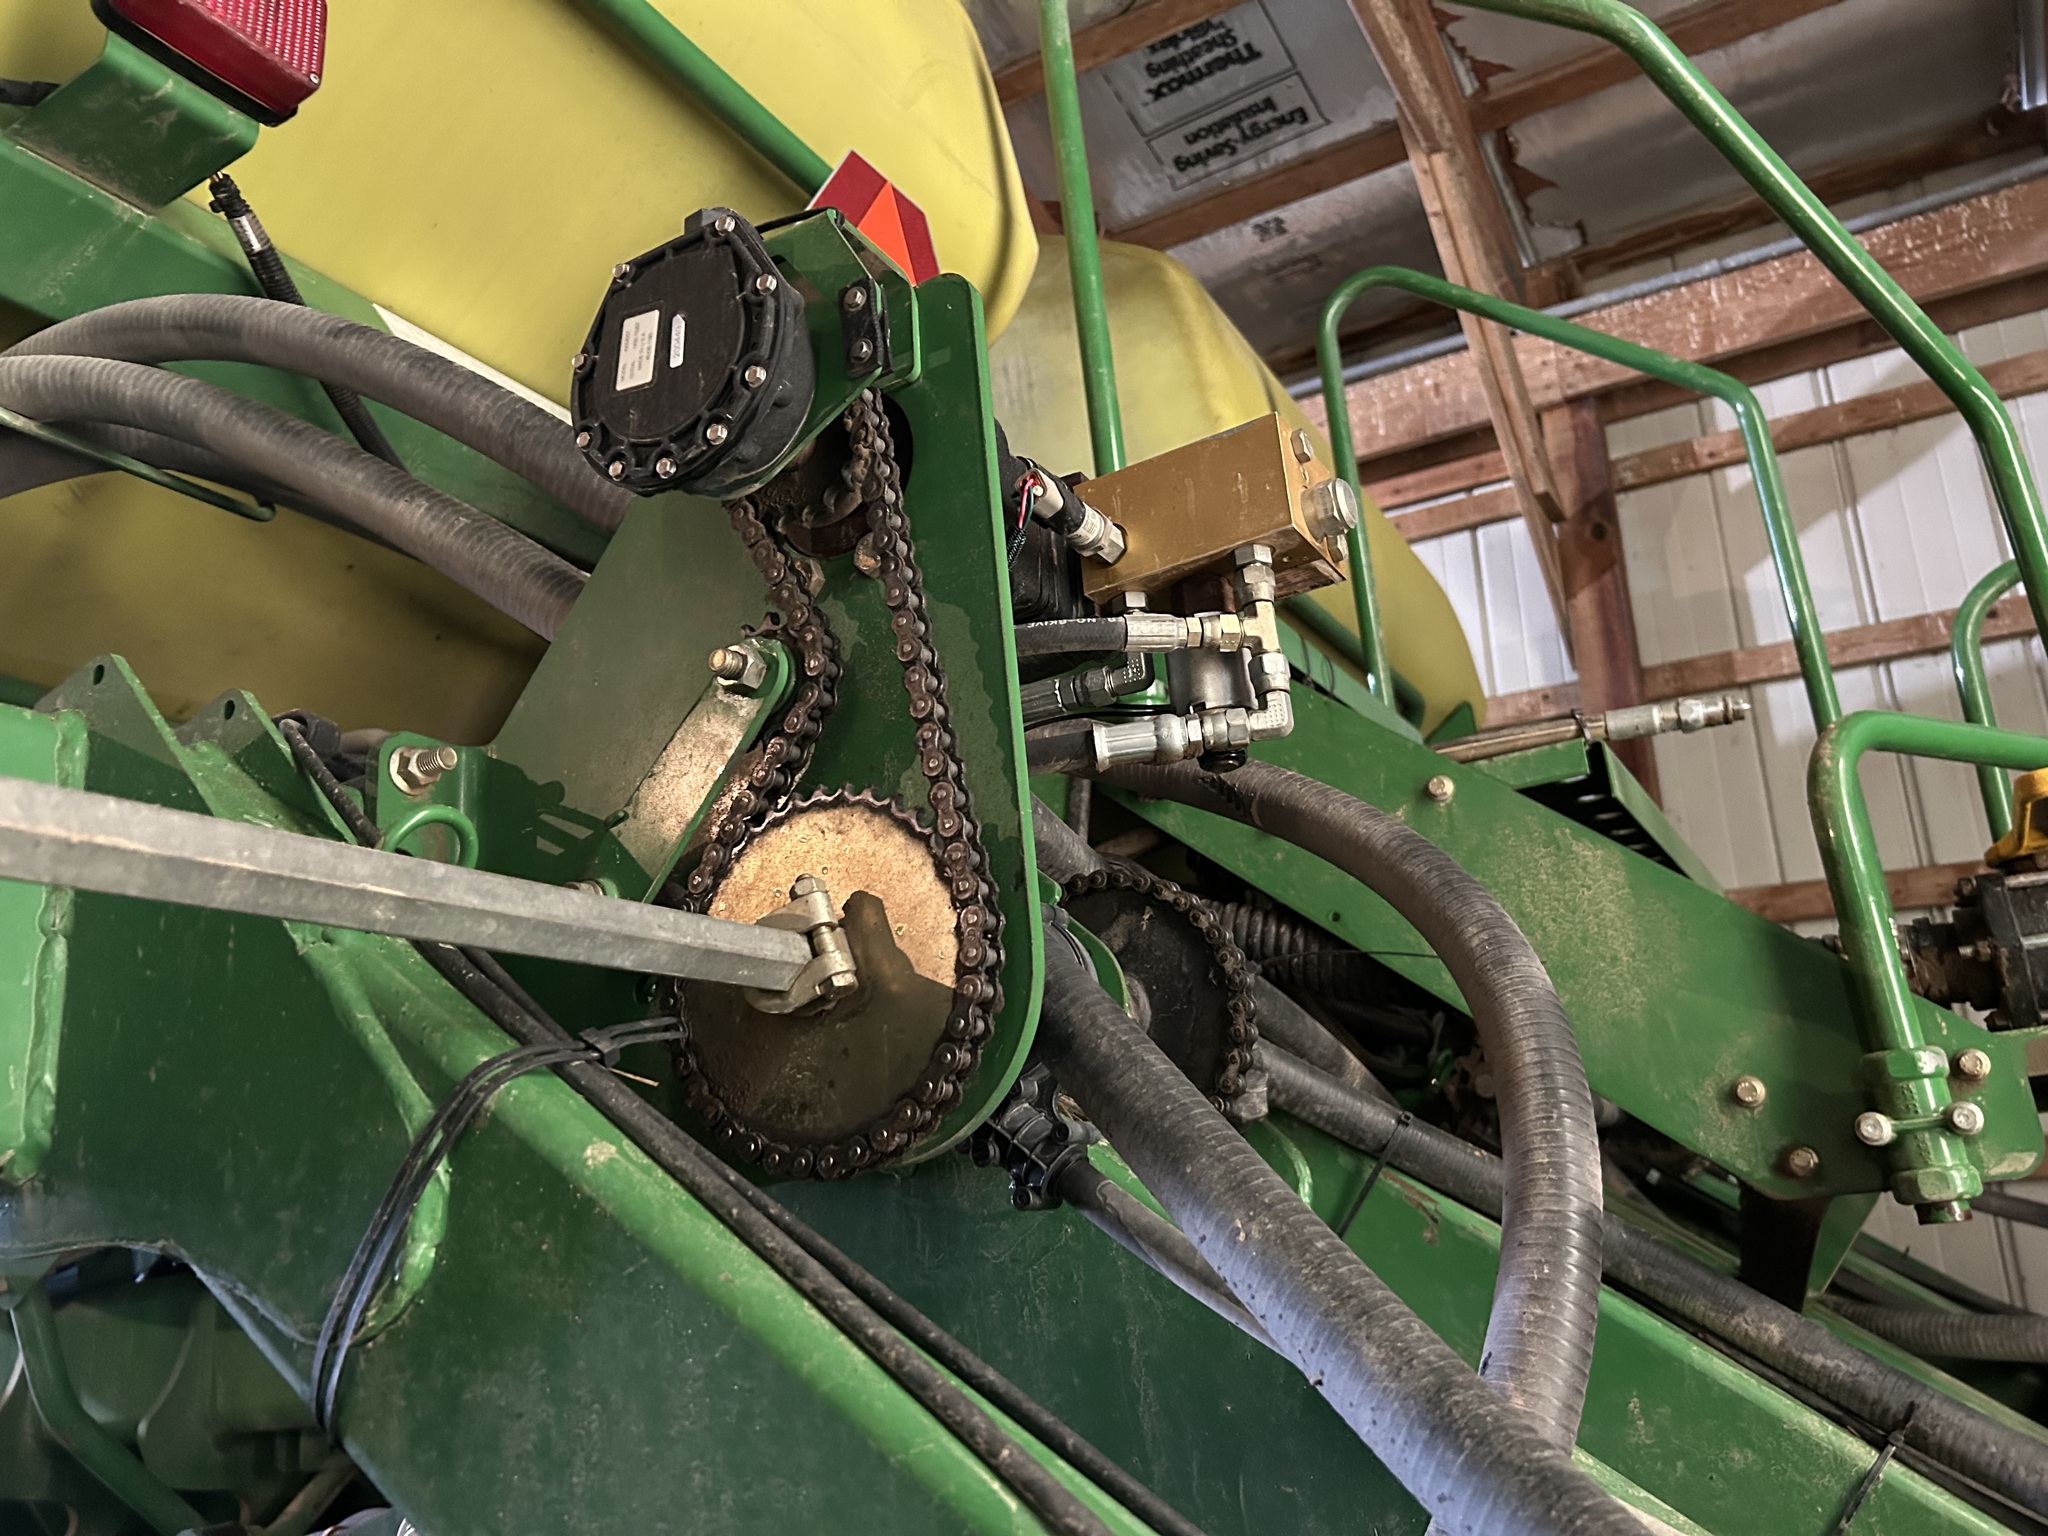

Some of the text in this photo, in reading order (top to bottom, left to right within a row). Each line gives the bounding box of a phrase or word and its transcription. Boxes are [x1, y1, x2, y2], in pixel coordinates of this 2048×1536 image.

[1145, 28, 1238, 78] Sheathing
[1147, 42, 1263, 101] Thermax
[1173, 106, 1309, 172] Energy-Saving
[1183, 97, 1277, 145] Insulation
